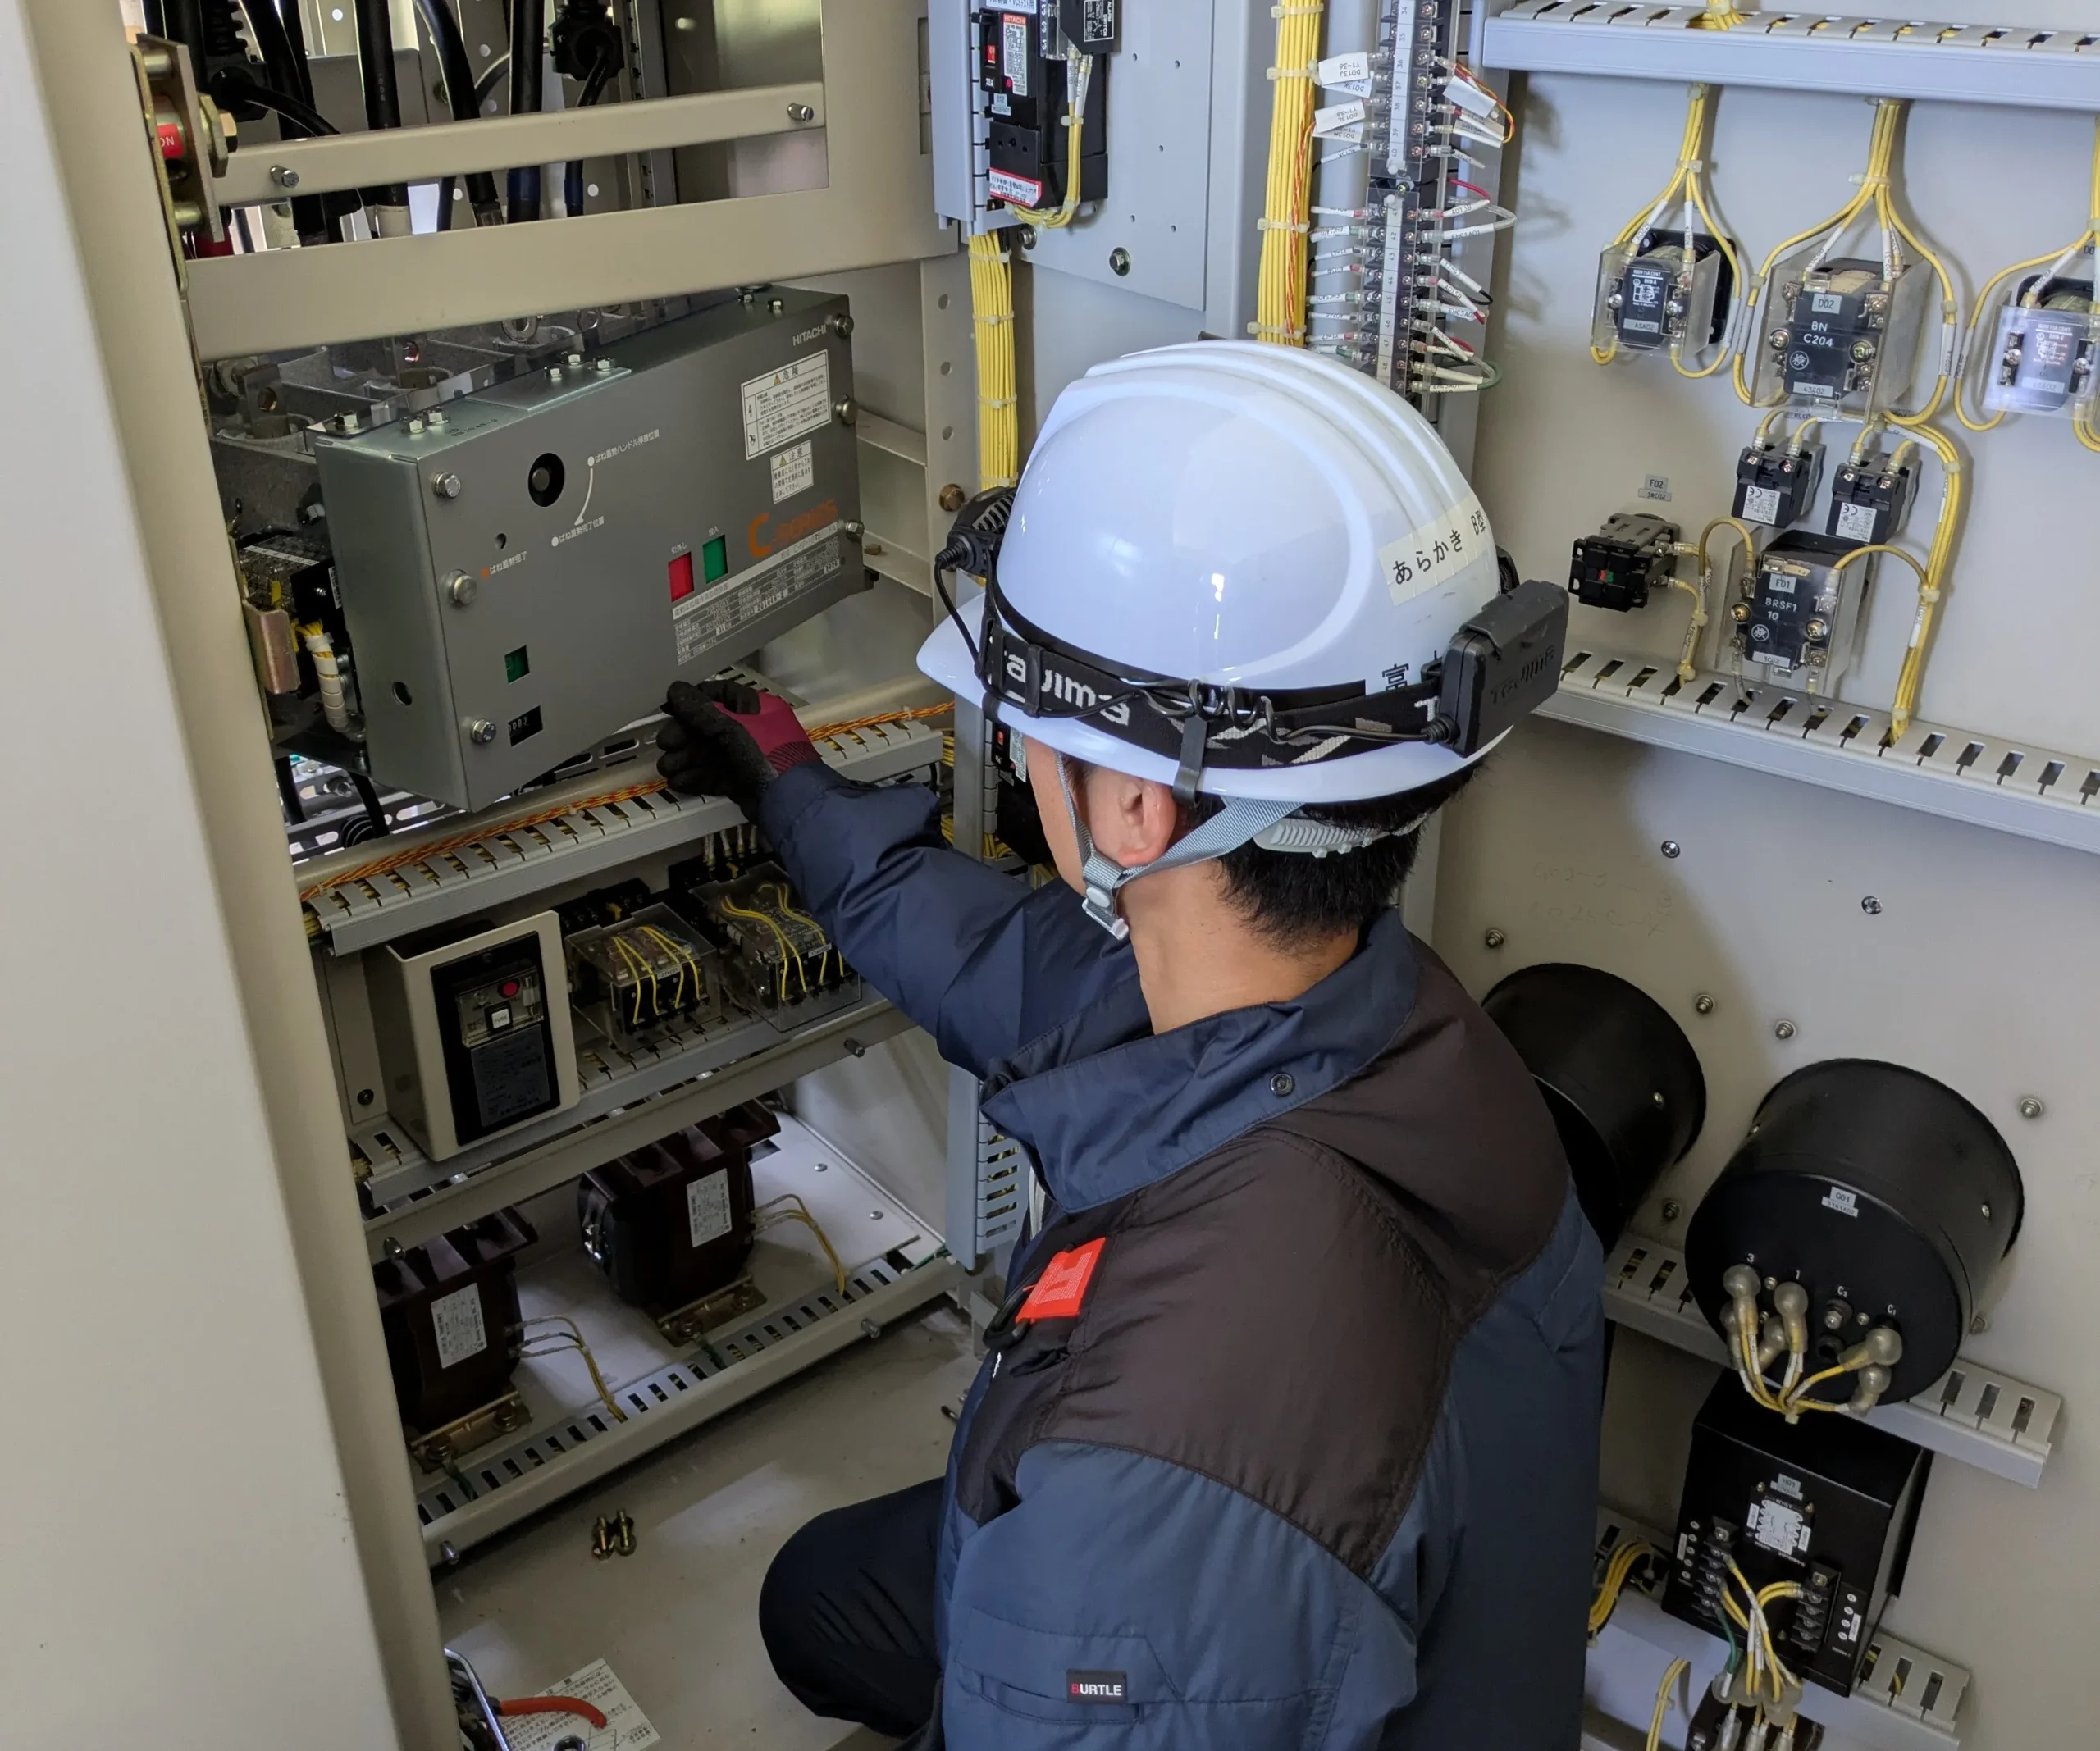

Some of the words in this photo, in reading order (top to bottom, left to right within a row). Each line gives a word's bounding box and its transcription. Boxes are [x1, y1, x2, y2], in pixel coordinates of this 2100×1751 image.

[1004, 16, 1026, 24] HITACHI
[2084, 245, 2095, 255] D0
[1818, 298, 1834, 309] D02
[1811, 321, 1828, 332] BN
[792, 324, 827, 346] HITACHI
[1803, 333, 1833, 347] C204
[1650, 478, 1664, 489] F02
[1392, 529, 1463, 585] あらかき
[1775, 578, 1791, 590] F01
[1764, 596, 1796, 613] BRSF1
[1767, 611, 1778, 621] 10
[1747, 1253, 1755, 1263] 3
[1071, 1683, 1122, 1696] BURTLE
